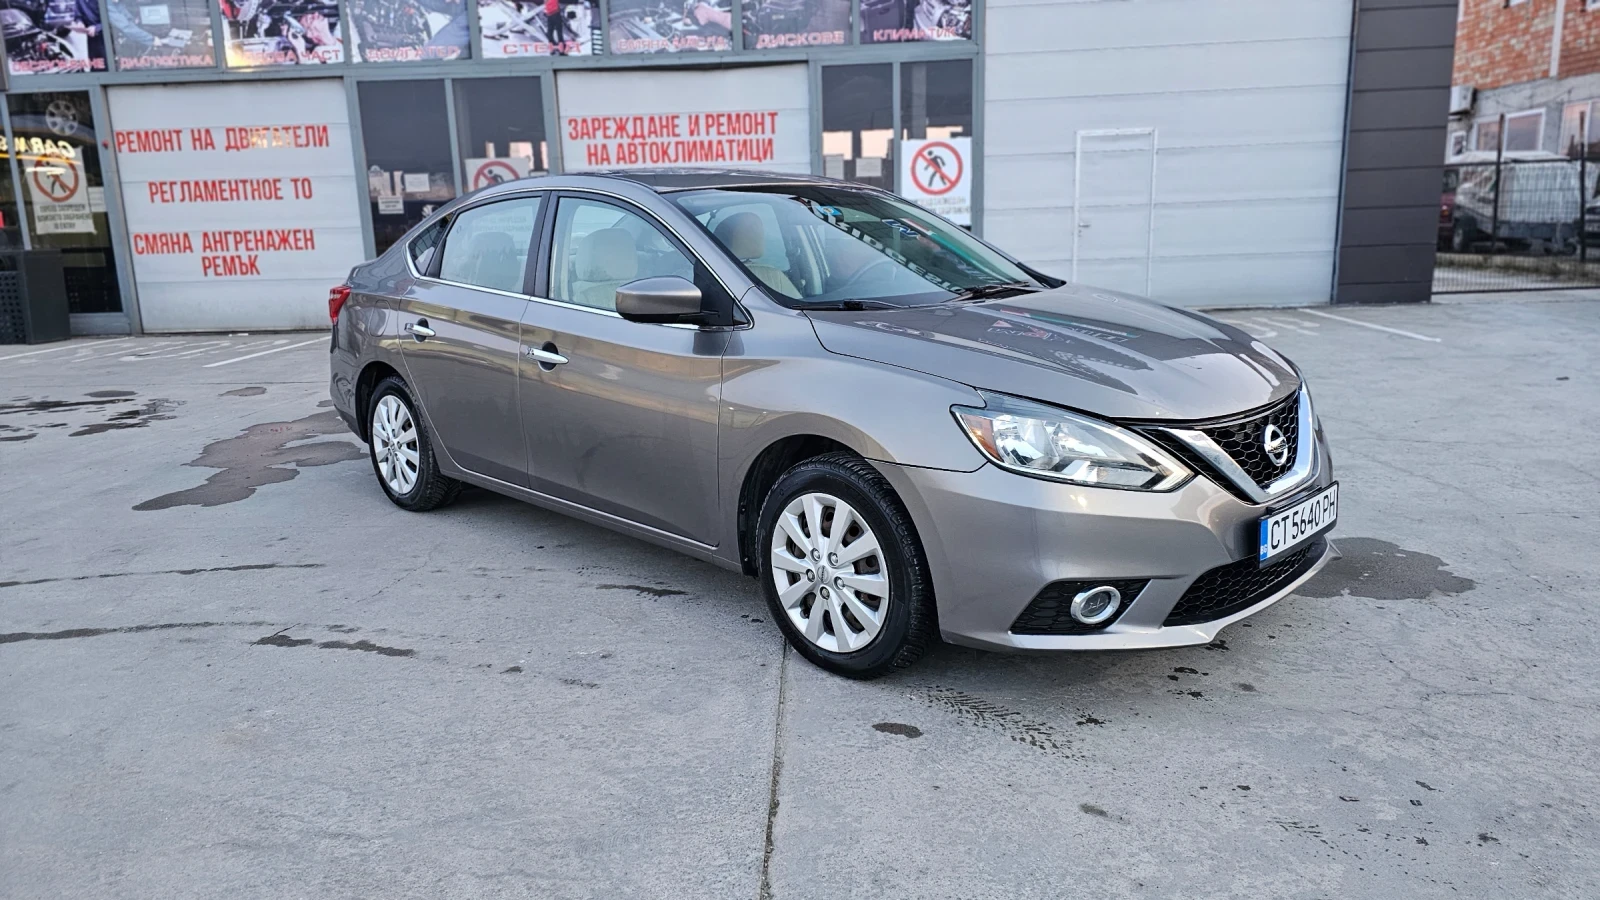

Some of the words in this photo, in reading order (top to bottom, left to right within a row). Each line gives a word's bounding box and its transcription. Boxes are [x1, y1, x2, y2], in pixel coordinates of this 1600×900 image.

[756, 31, 844, 49] ДИСКОВЕ
[873, 26, 956, 41] КЛИМАТИК
[120, 55, 213, 69] ДИАГНОСТИКА
[301, 49, 341, 61] ЧАСТ
[568, 115, 681, 140] ЗАРЕЖДАНЕ
[688, 114, 700, 136] И
[705, 111, 779, 136] РЕМОНТ
[115, 129, 182, 153] РЕМОНТ
[191, 128, 215, 150] НА
[225, 125, 329, 152] ДВИГАТЕЛИ
[587, 143, 611, 166] НА
[616, 138, 774, 165] АВТОКЛИМАТИЦИ
[148, 178, 284, 203] РЕГЛАМЕНТНОЕ
[291, 177, 312, 199] ТО
[133, 232, 193, 255] СМЯНА
[202, 229, 315, 253] АНГРЕНАЖЕН
[202, 254, 261, 277] РЕМЪК
